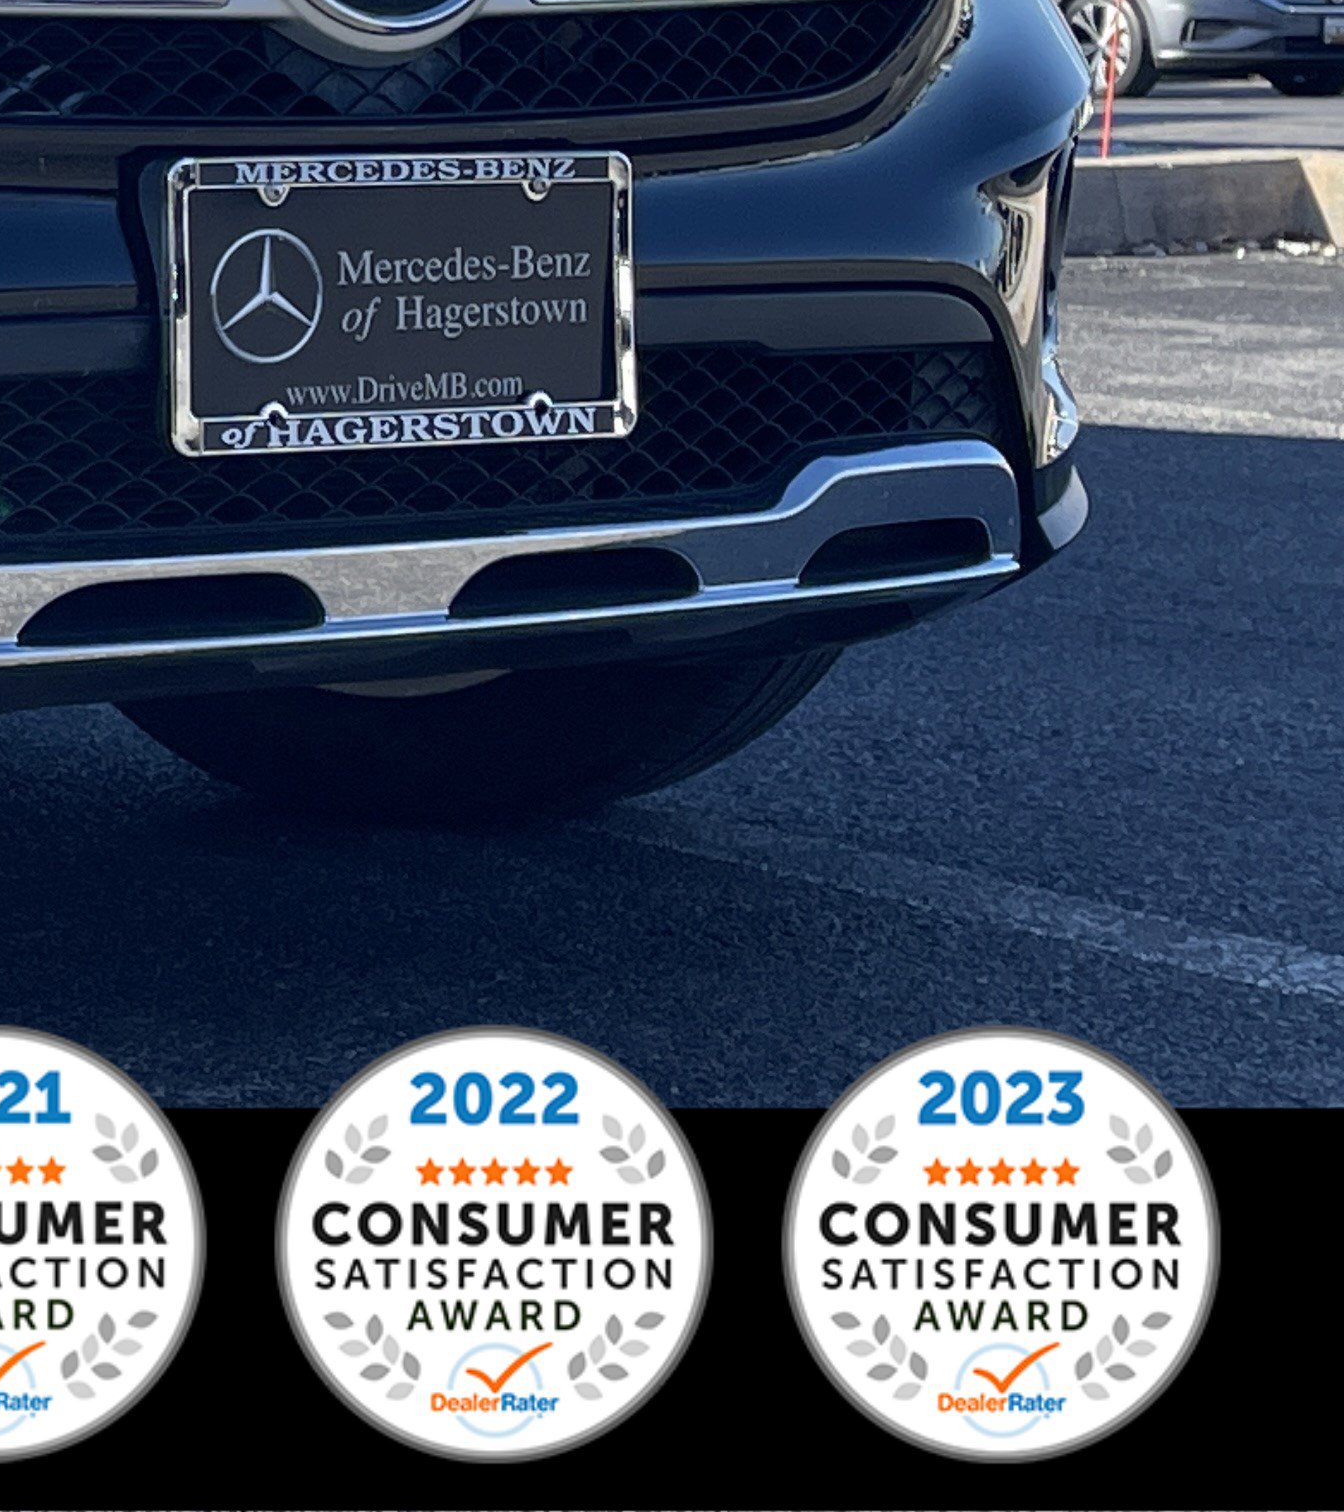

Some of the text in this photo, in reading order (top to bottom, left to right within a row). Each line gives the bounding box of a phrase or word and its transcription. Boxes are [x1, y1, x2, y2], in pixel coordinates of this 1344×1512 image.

[234, 157, 577, 185] MERCEDES-BENZ
[336, 244, 592, 286] Mercedes-Benz
[340, 294, 589, 341] of Hagerstown
[286, 370, 524, 407] www.DriveMB.com
[220, 407, 597, 449] of HAGERSTOWN
